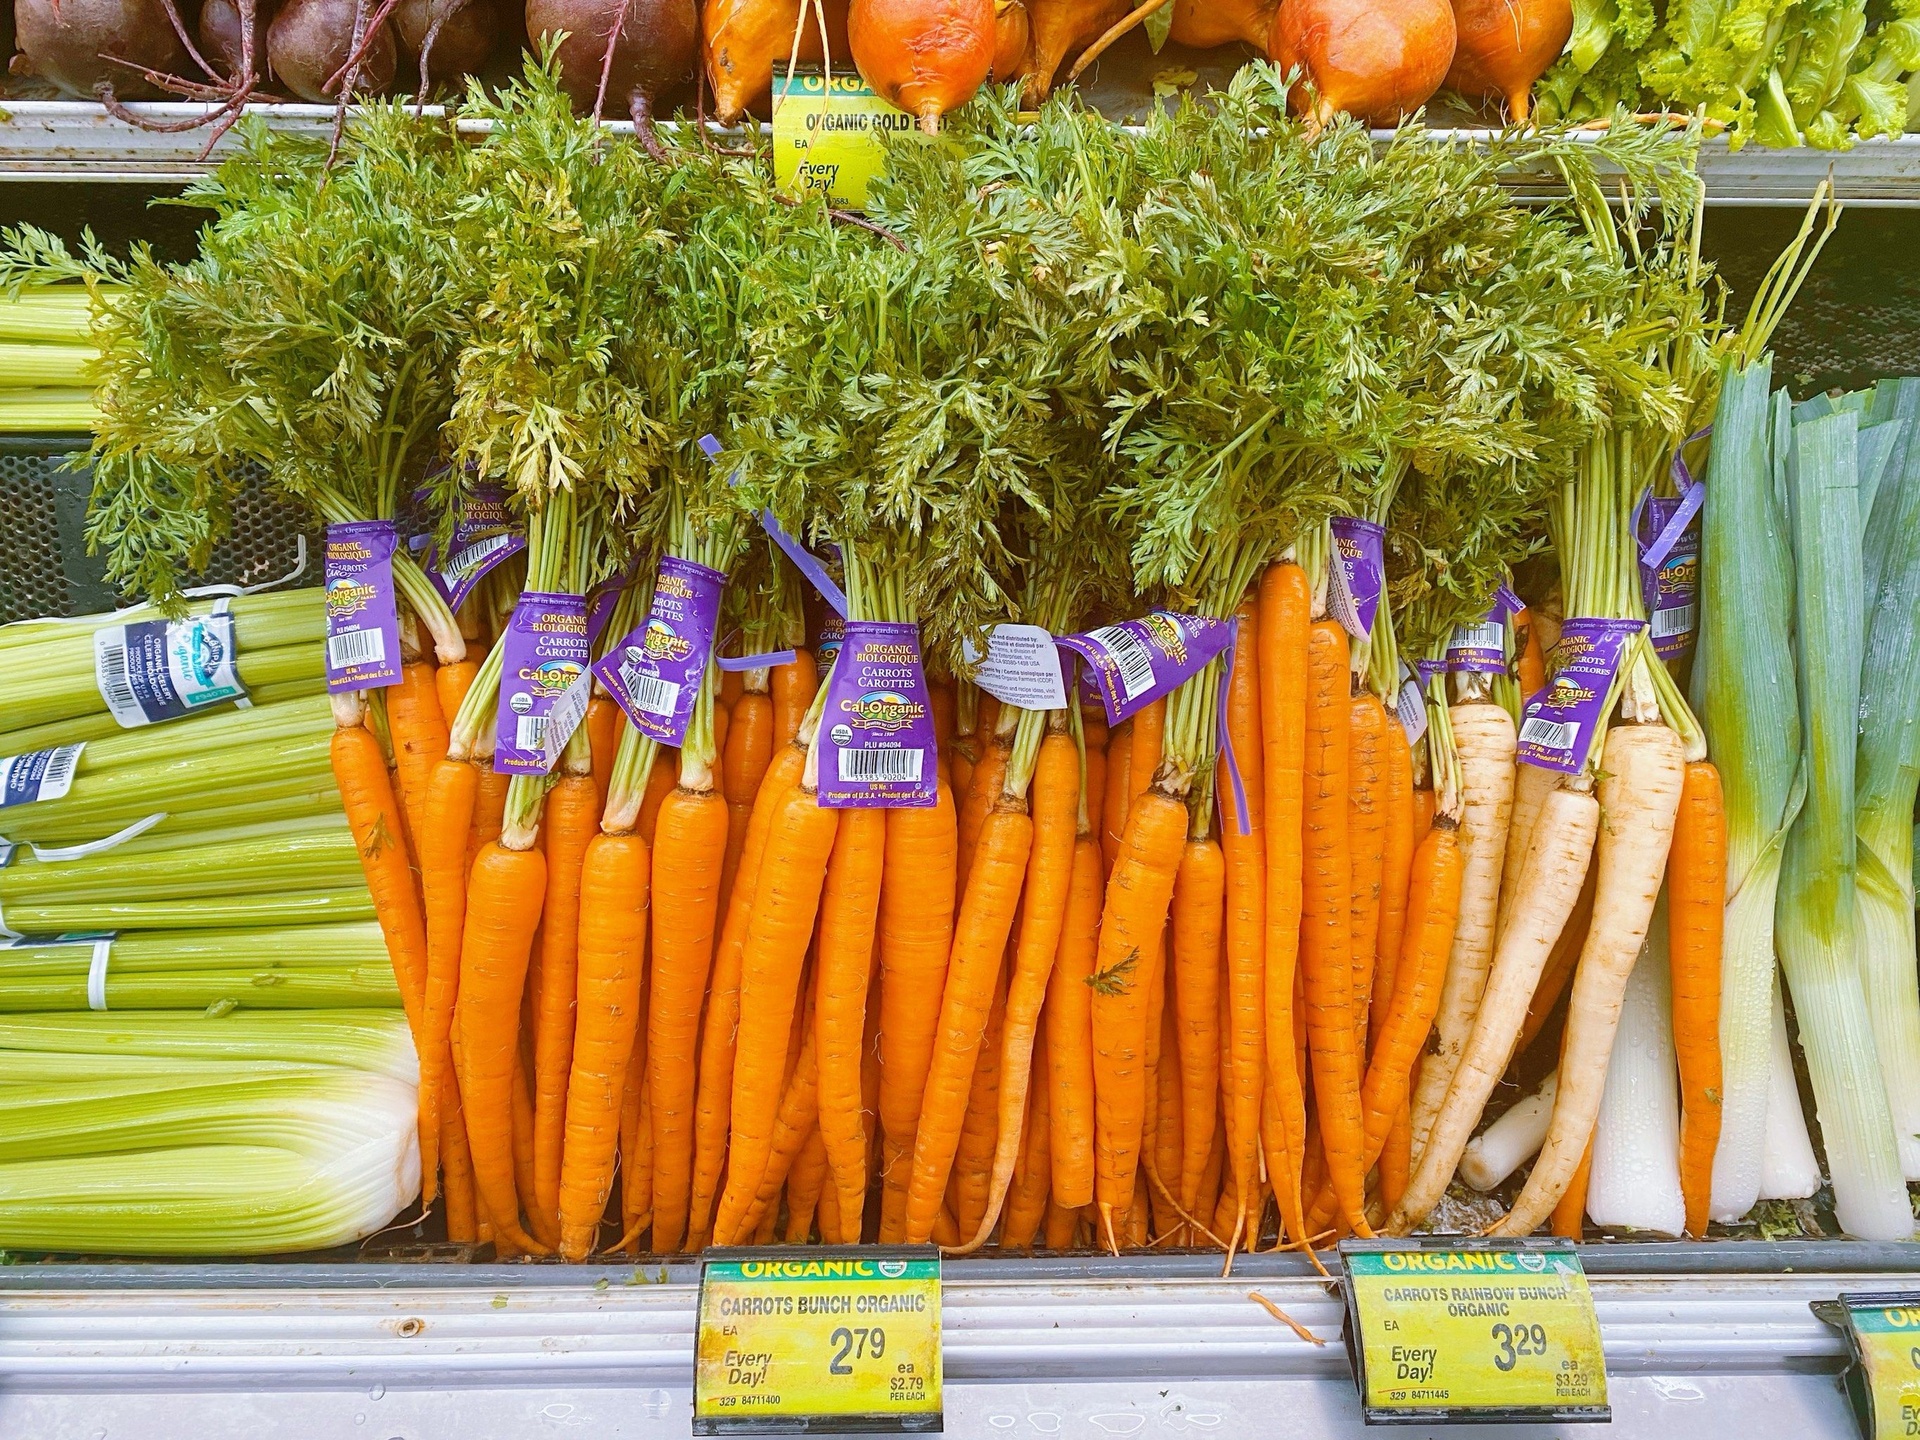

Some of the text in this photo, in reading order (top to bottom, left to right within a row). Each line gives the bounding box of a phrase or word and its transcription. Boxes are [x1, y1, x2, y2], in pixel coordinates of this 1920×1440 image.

[806, 113, 909, 131] ORGANIC GOLD
[794, 140, 808, 149] EA
[800, 162, 839, 176] Every
[806, 176, 835, 192] Day!
[328, 541, 362, 551] ORGANIC
[550, 598, 569, 606] home
[541, 613, 588, 626] ORGANIC
[532, 622, 588, 637] BIOLOGIQU
[876, 627, 899, 635] garden
[1126, 628, 1138, 641] PLU
[539, 636, 588, 648] CARROTS
[865, 643, 913, 654] ORGANIC
[535, 646, 589, 659] CAROTTE
[128, 648, 136, 672] PRODUIT
[857, 653, 919, 666] BIOLOGIQUE
[144, 635, 166, 706] CÉLERI BIOLOGIQUE
[154, 638, 173, 701] ORGANIC CELERY
[862, 666, 912, 678] CARROTS
[1119, 662, 1131, 686] 90204
[858, 677, 915, 688] CAROTTES
[840, 699, 925, 717] Cal-Organic
[504, 758, 527, 766] Produce
[1383, 1251, 1516, 1271] ORGANIC
[741, 1261, 874, 1279] ORGANIC
[1384, 1286, 1567, 1302] CARROTS RAINBOW BUNCH
[720, 1294, 926, 1316] CARROTS BUNCH ORGANIC
[1448, 1303, 1510, 1317] ORGANIC
[723, 1326, 738, 1335] EA
[1384, 1320, 1399, 1331] EA
[725, 1351, 772, 1369] Every
[1391, 1346, 1437, 1366] Every
[897, 1363, 915, 1374] ea
[1561, 1360, 1578, 1370] ea
[728, 1368, 767, 1388] Day!
[1397, 1362, 1434, 1383] Day!
[890, 1377, 923, 1390] $2.79
[1556, 1373, 1589, 1387] $3.29
[890, 1392, 926, 1401] PER EACH
[1390, 1390, 1449, 1400] 329 84711445
[1556, 1388, 1591, 1397] PER EACH
[719, 1395, 781, 1406] 329 84711400
